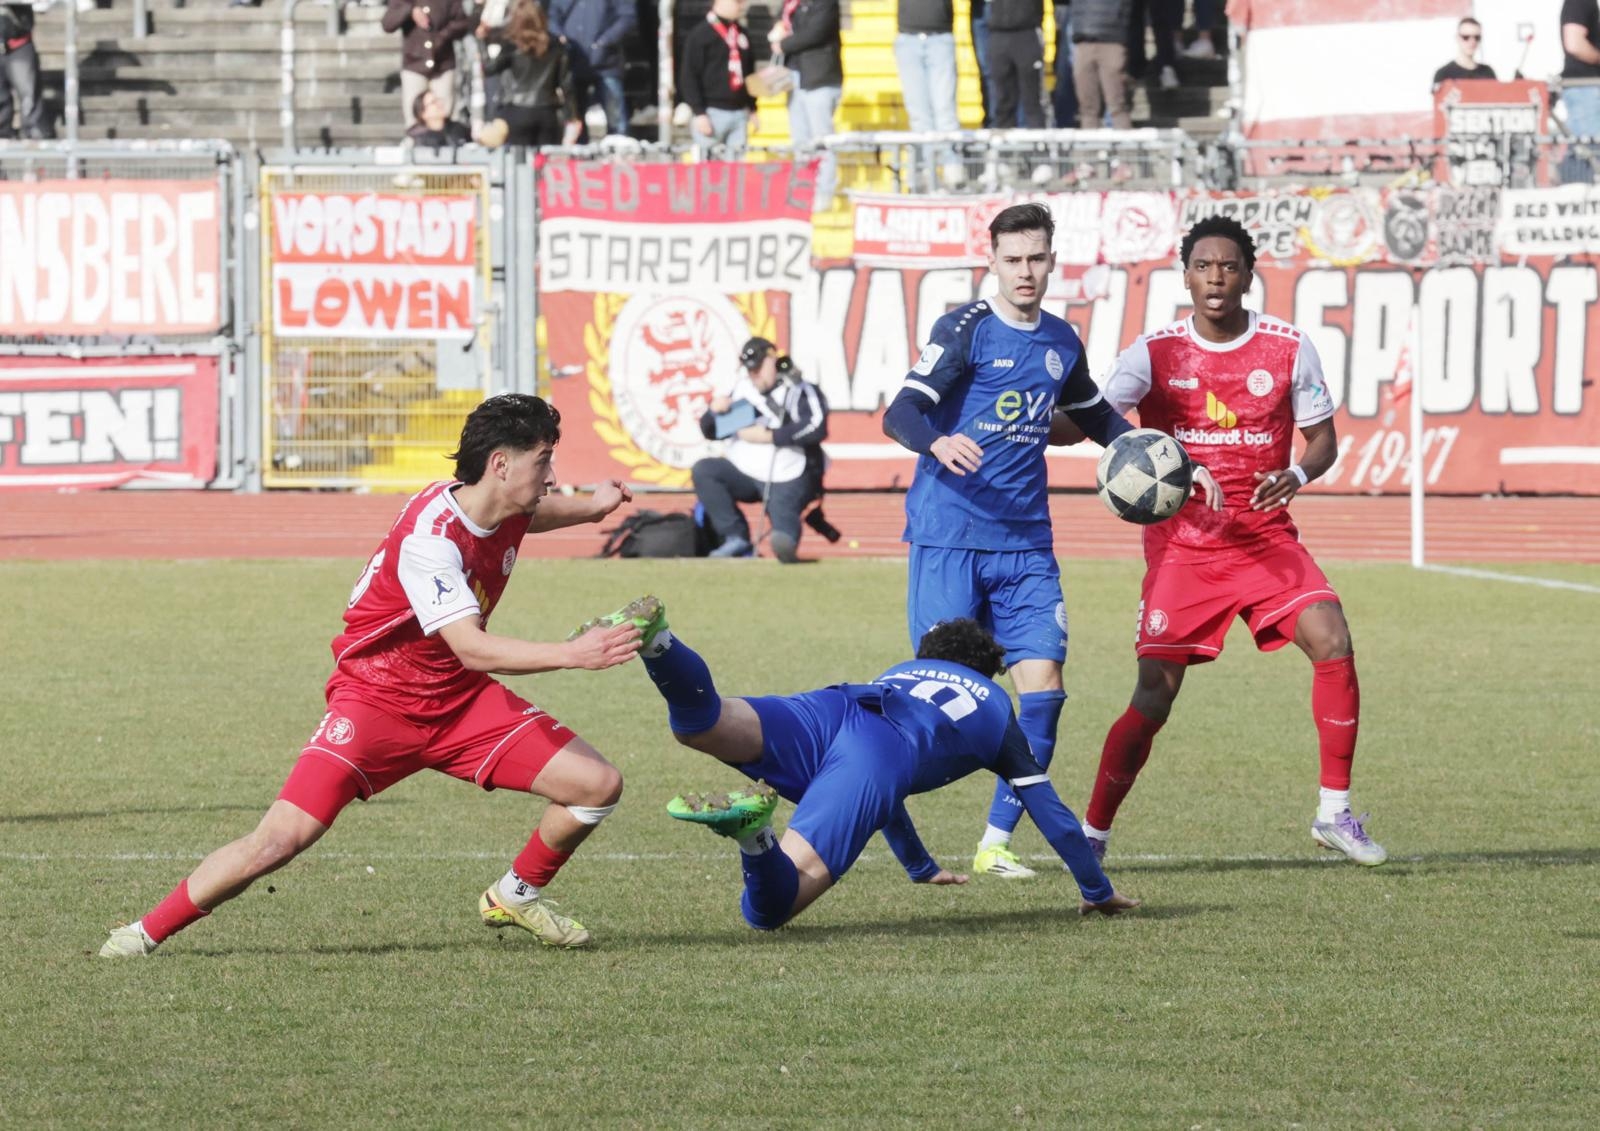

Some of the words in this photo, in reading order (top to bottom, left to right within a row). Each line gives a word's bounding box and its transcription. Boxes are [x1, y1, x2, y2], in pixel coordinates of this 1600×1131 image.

[274, 194, 475, 261] VORSTADT
[278, 268, 475, 331] LÖWEN
[1296, 267, 1598, 417] SPORT
[1174, 424, 1242, 445] bickhardt
[1244, 430, 1273, 445] bau
[1002, 795, 1024, 808] JAK
